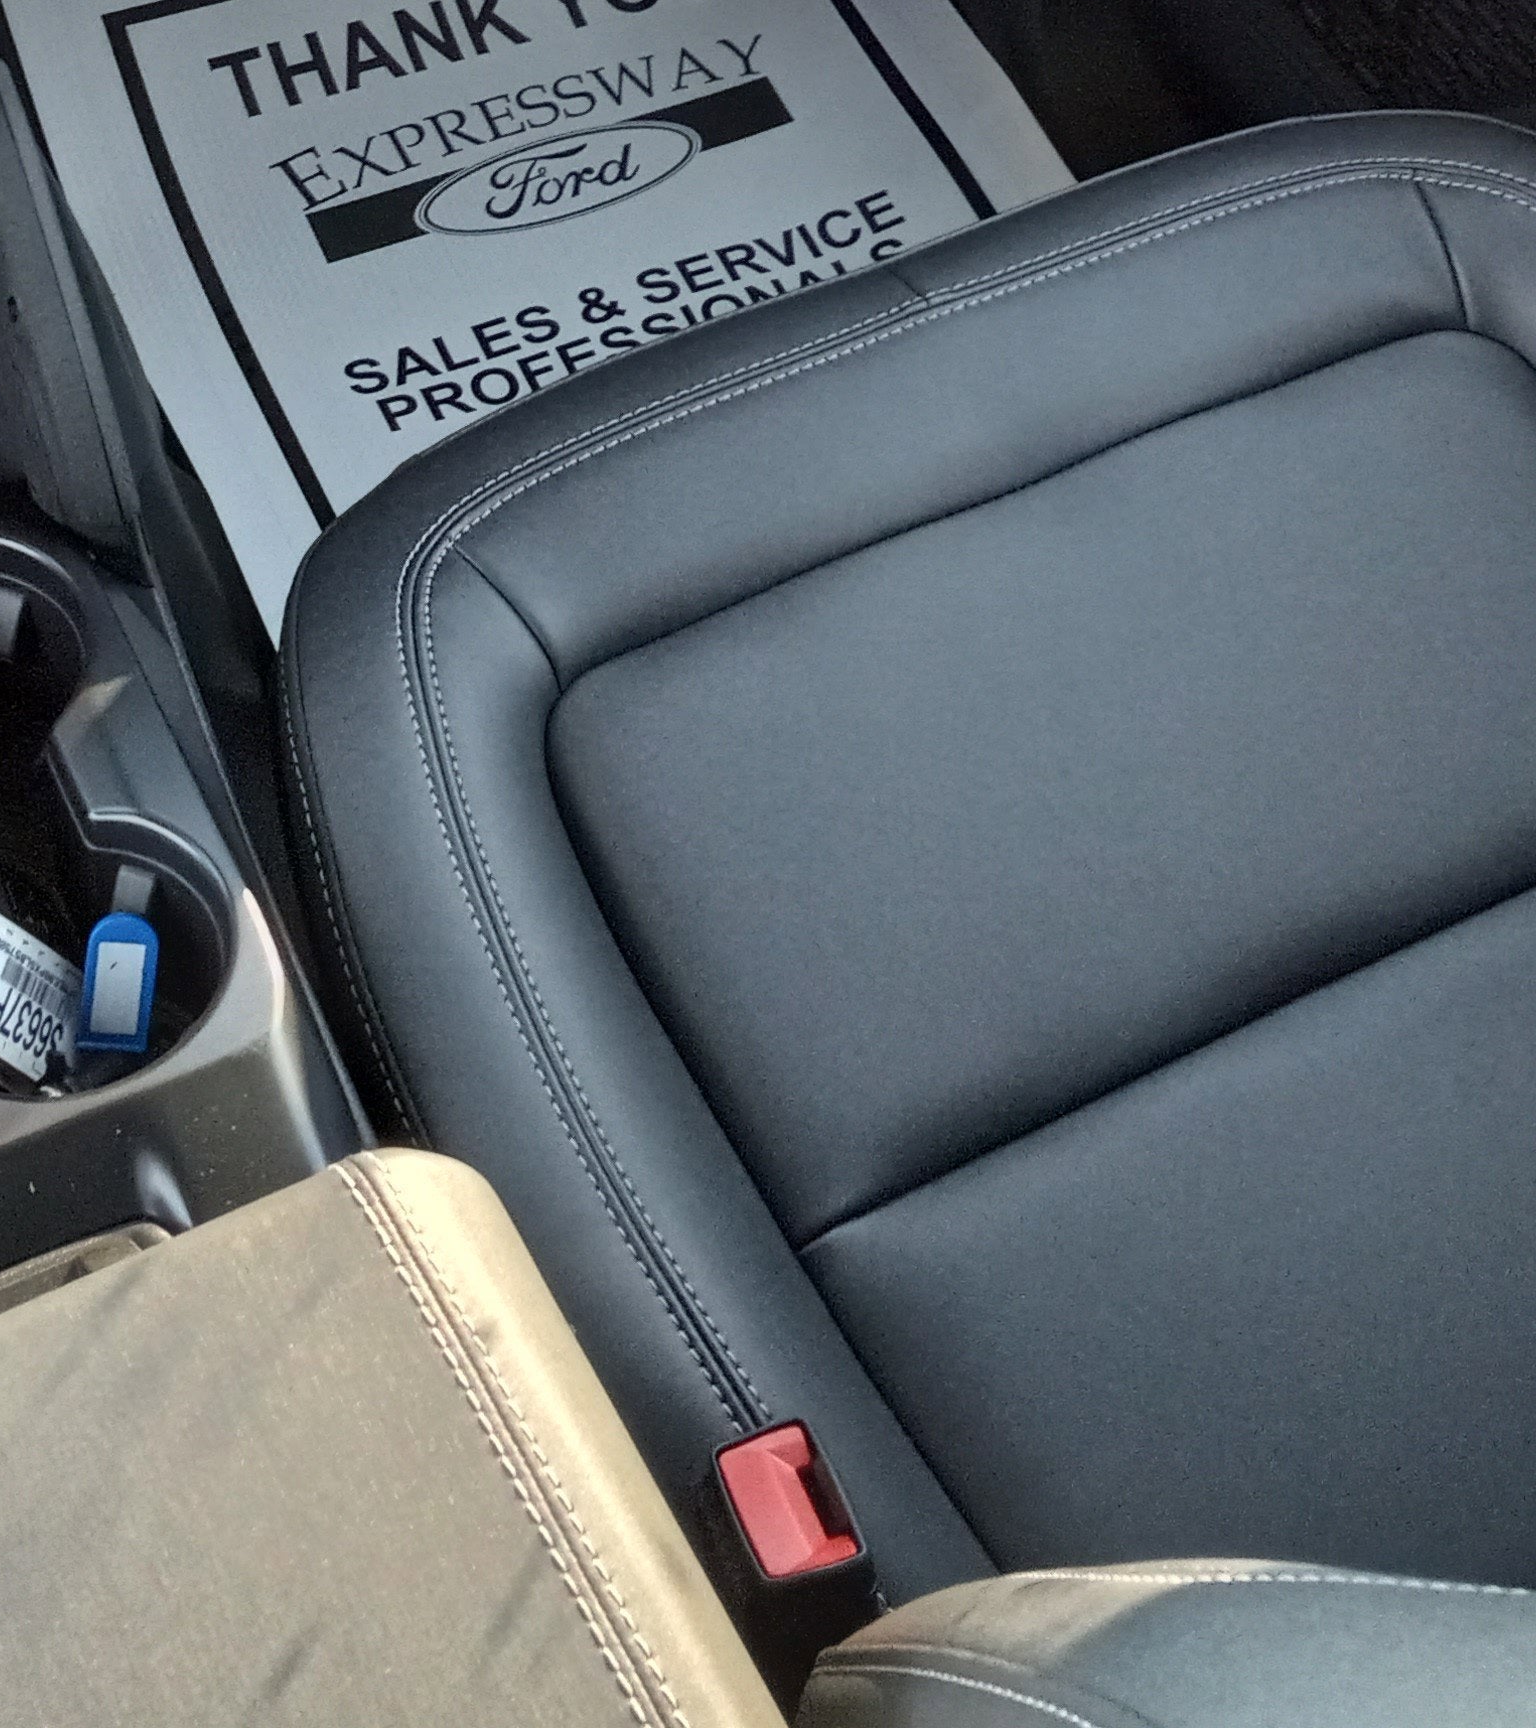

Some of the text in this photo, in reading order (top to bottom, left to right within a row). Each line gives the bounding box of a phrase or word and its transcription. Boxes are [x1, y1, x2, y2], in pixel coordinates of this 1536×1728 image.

[268, 34, 764, 212] EXPRESSWAY
[484, 142, 641, 221] Ford
[343, 189, 905, 396] SALES & SERVICE
